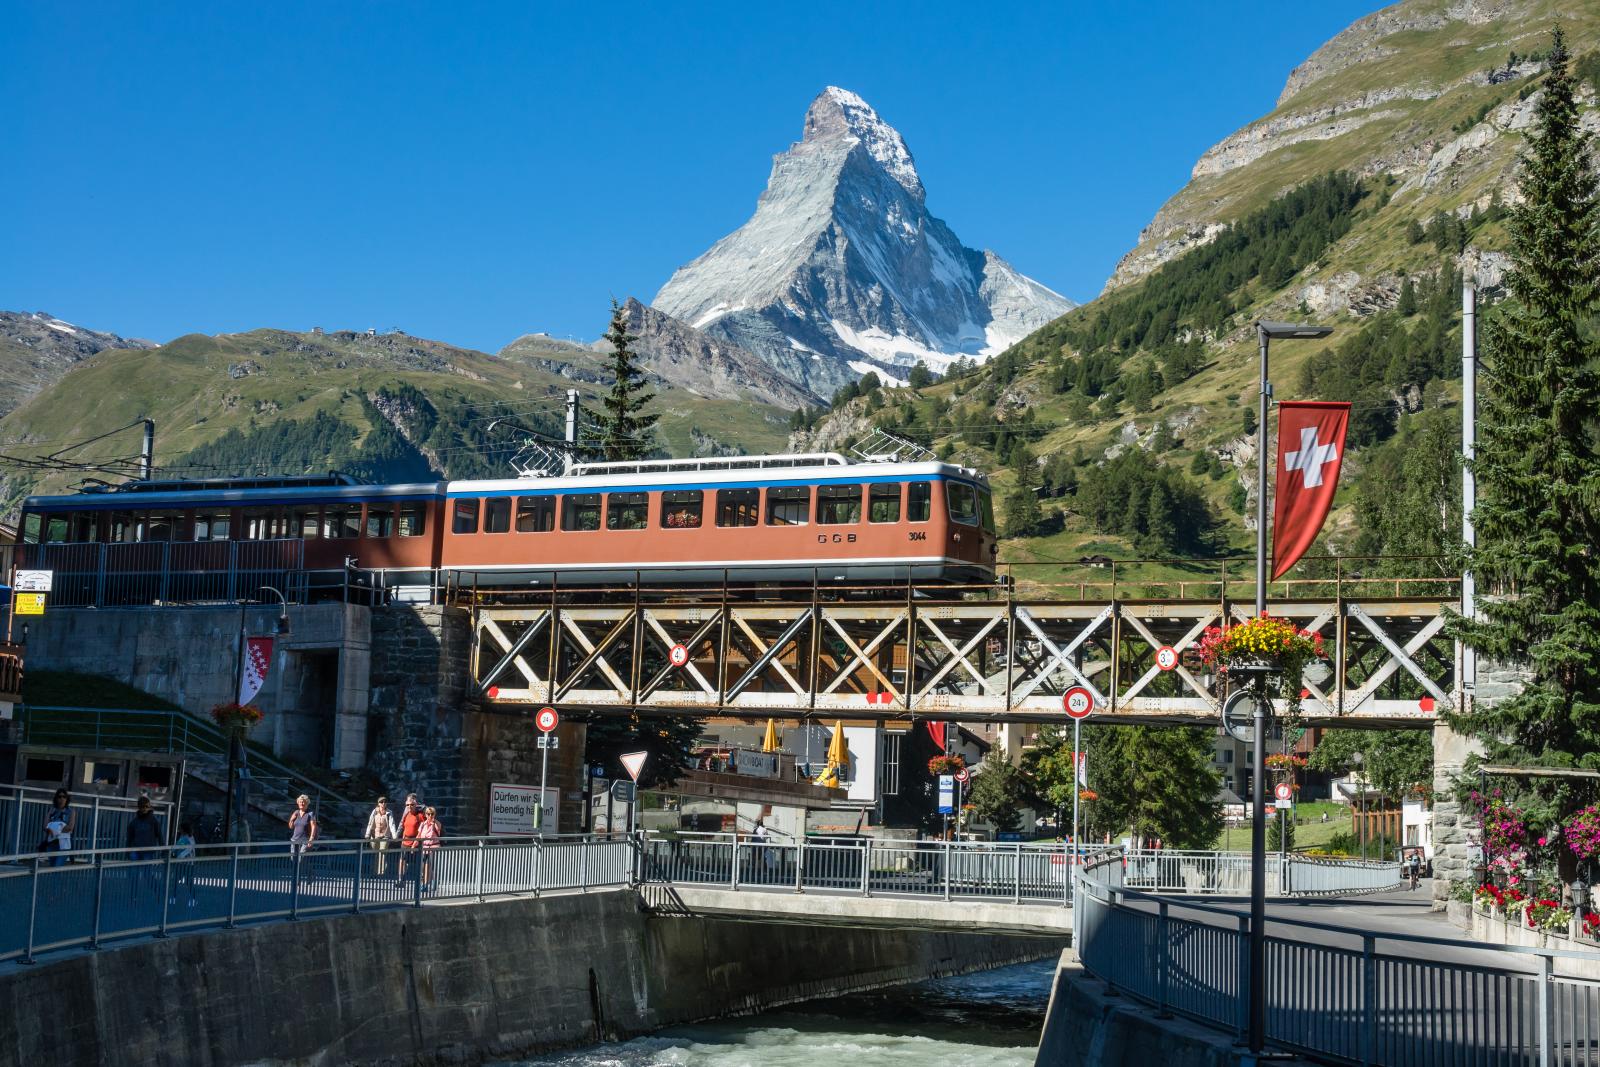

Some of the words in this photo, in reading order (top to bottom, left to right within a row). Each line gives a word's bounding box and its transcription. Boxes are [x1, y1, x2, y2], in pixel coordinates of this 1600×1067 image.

[908, 531, 926, 541] 3044
[494, 791, 519, 802] Dürfen
[520, 794, 532, 803] wir
[493, 804, 524, 817] lebendig
